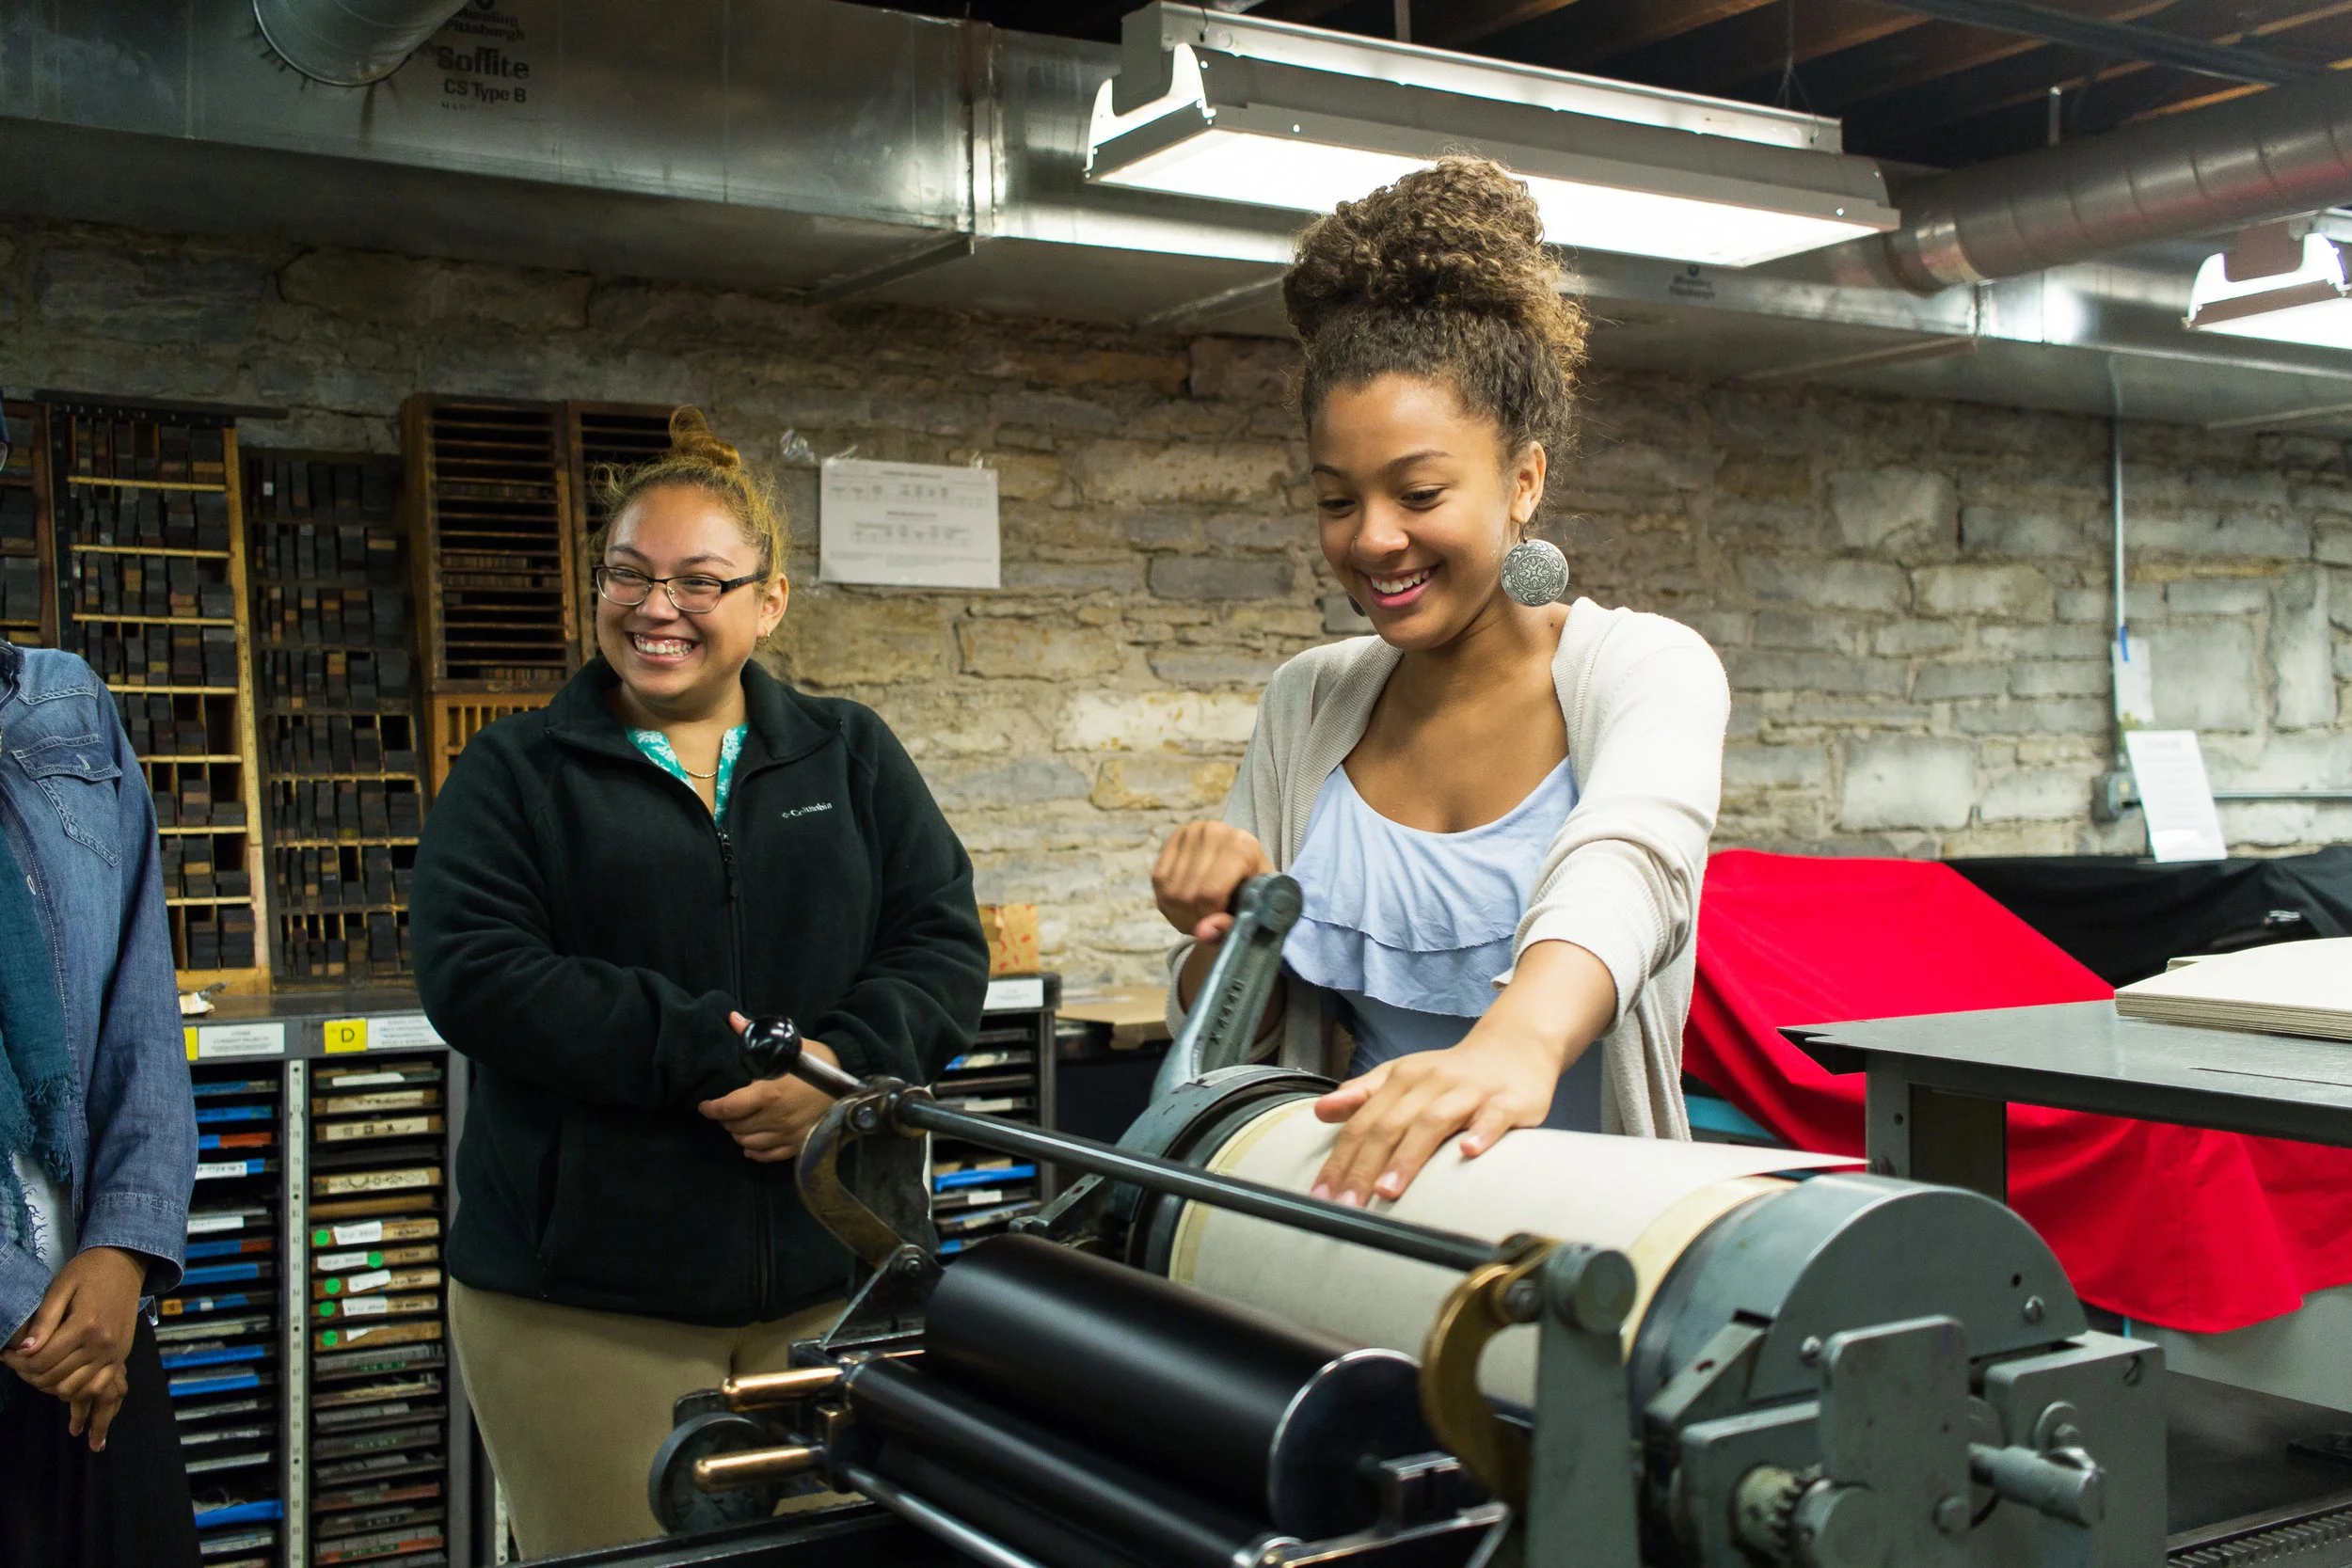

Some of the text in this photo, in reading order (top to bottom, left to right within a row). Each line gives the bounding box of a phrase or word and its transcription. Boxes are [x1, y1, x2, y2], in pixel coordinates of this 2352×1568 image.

[444, 77, 527, 103] CS Type B
[790, 802, 833, 816] Columbia
[341, 1027, 355, 1043] D
